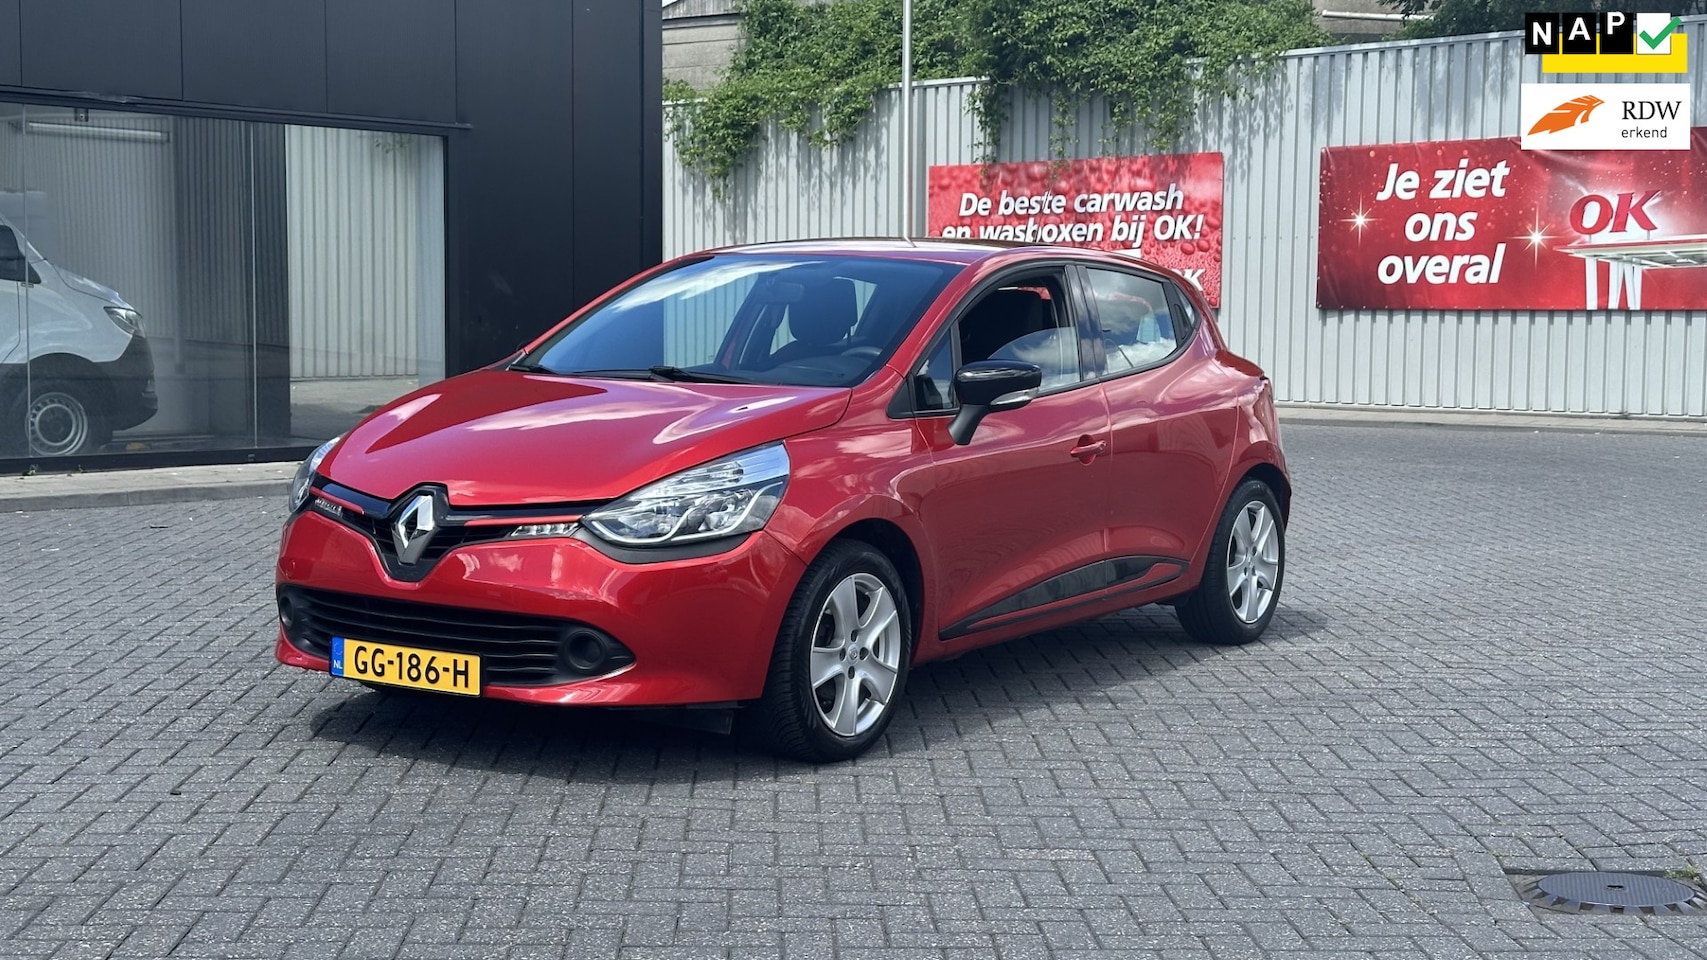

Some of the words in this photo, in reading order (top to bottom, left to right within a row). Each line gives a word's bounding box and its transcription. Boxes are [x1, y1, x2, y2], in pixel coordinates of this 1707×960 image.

[1376, 163, 1420, 201] Je
[1429, 158, 1510, 200] ziet
[959, 192, 992, 217] De
[998, 189, 1067, 216] beste
[1074, 183, 1184, 213] carwash
[1569, 190, 1662, 236] OK
[942, 225, 971, 239] en
[1111, 215, 1145, 248] bij
[1153, 214, 1204, 241] OK!
[1405, 210, 1478, 242] ons
[1171, 268, 1206, 291] K
[1377, 243, 1507, 285] overal
[333, 659, 343, 669] NL
[354, 645, 469, 688] GG-186-H
